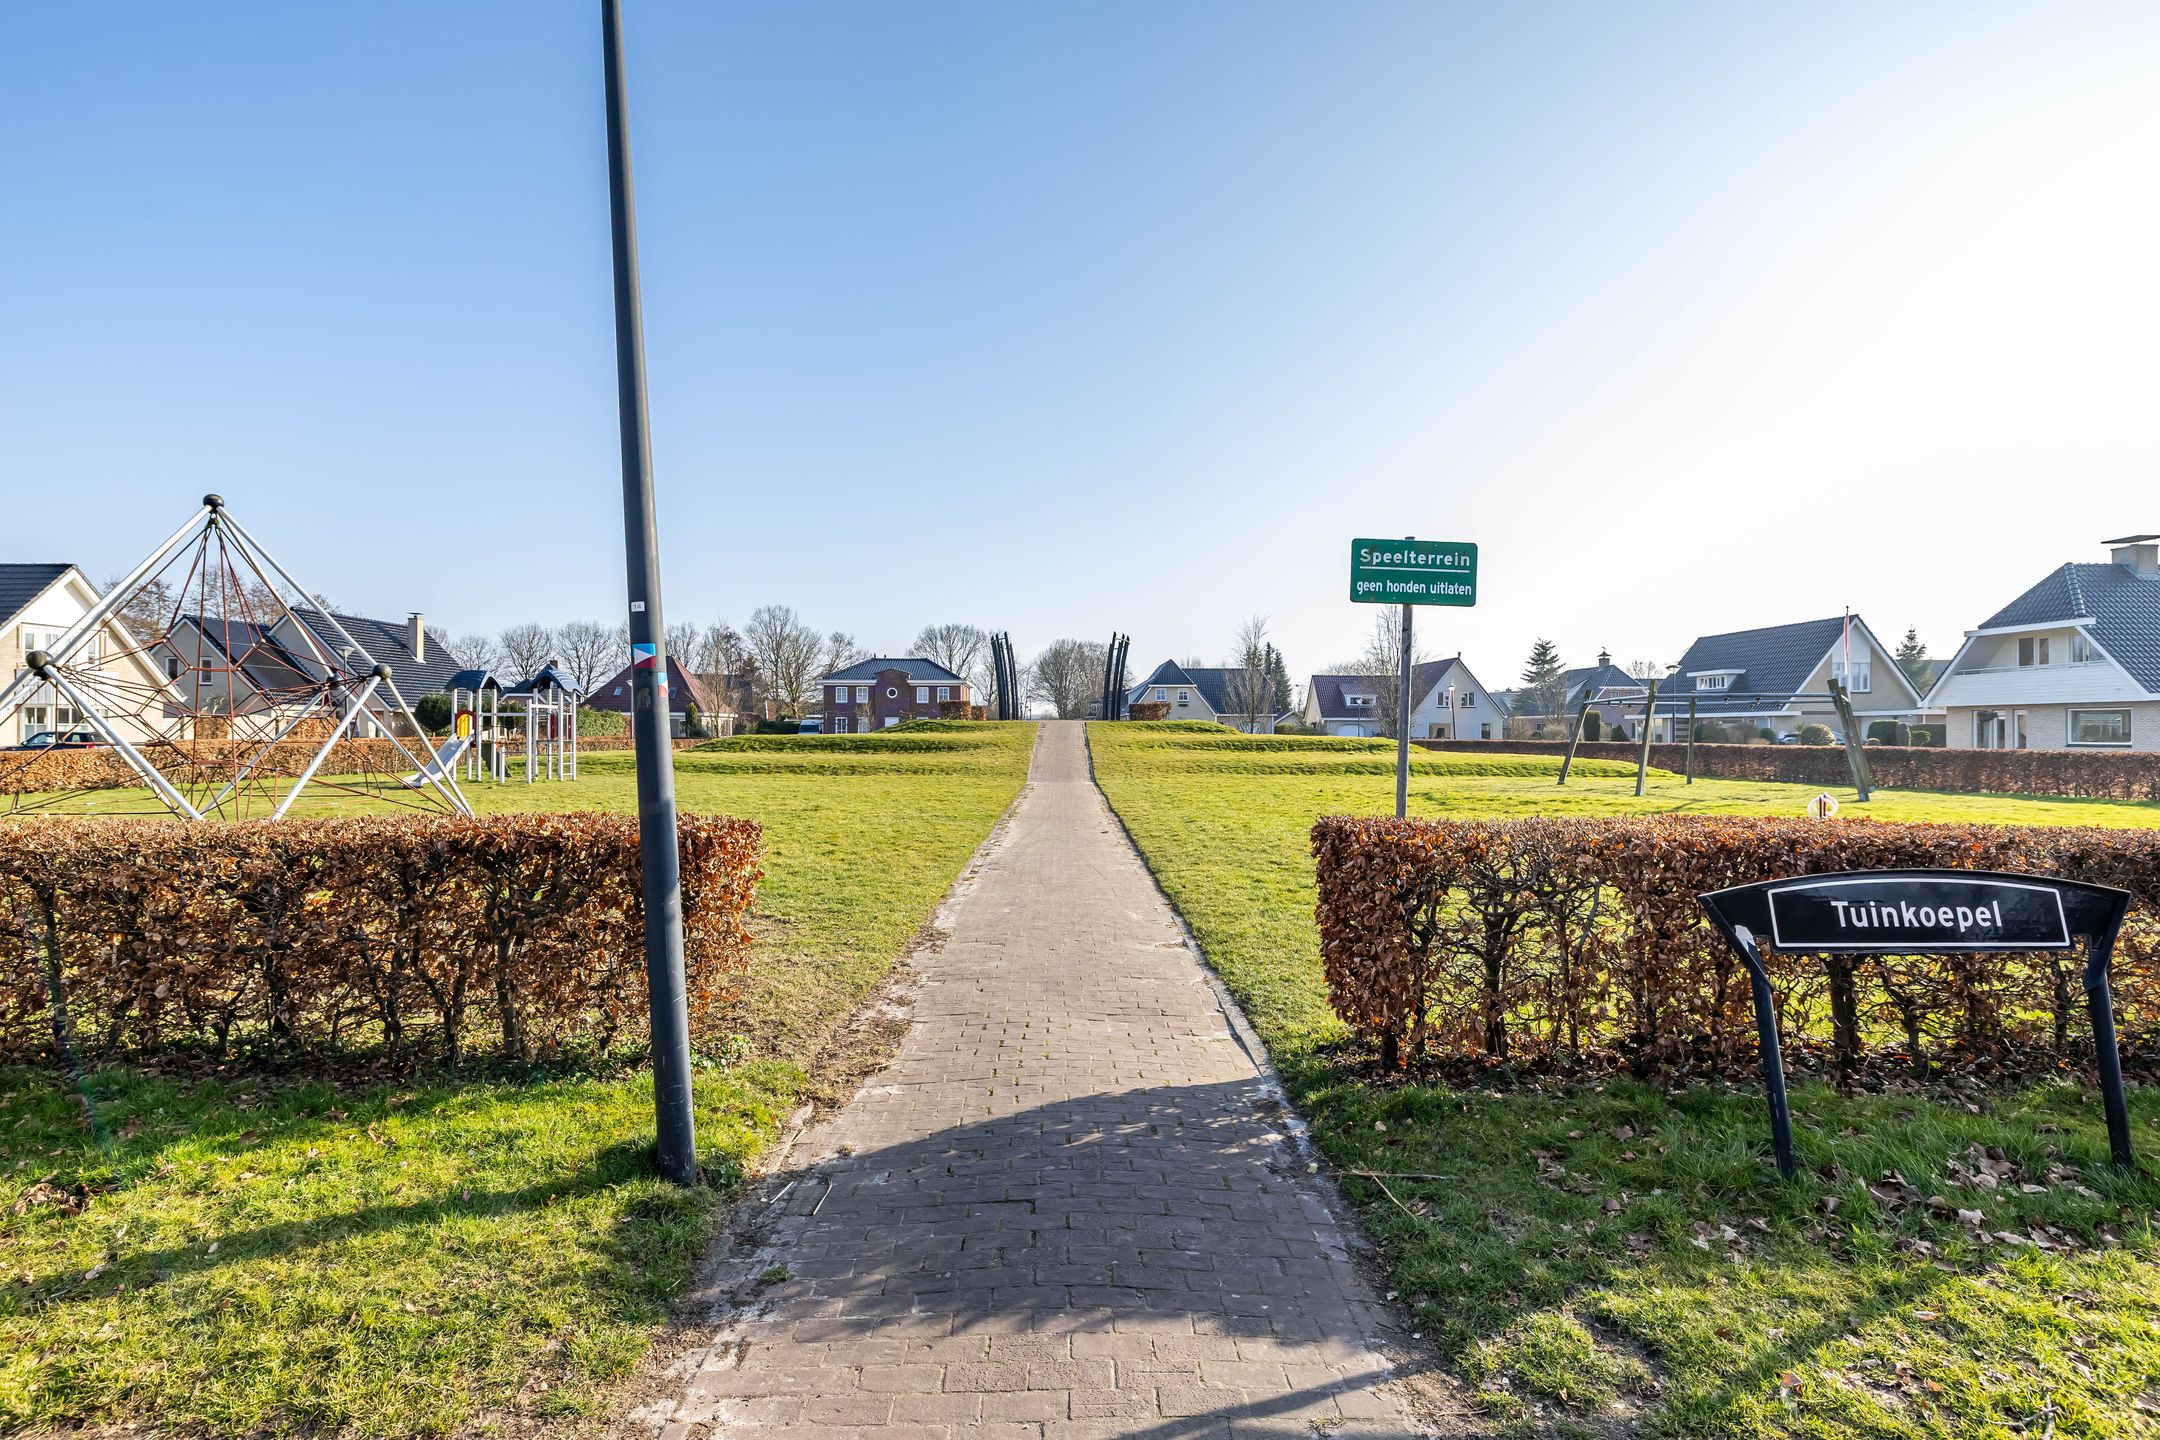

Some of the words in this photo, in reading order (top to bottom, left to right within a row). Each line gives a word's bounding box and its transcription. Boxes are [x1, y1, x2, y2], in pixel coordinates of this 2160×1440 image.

[1360, 549, 1470, 567] Speelterrein
[1357, 580, 1383, 595] geen
[1387, 579, 1426, 594] honden
[1430, 581, 1472, 596] uitlaten
[1830, 900, 2003, 933] Tuinkoepel
